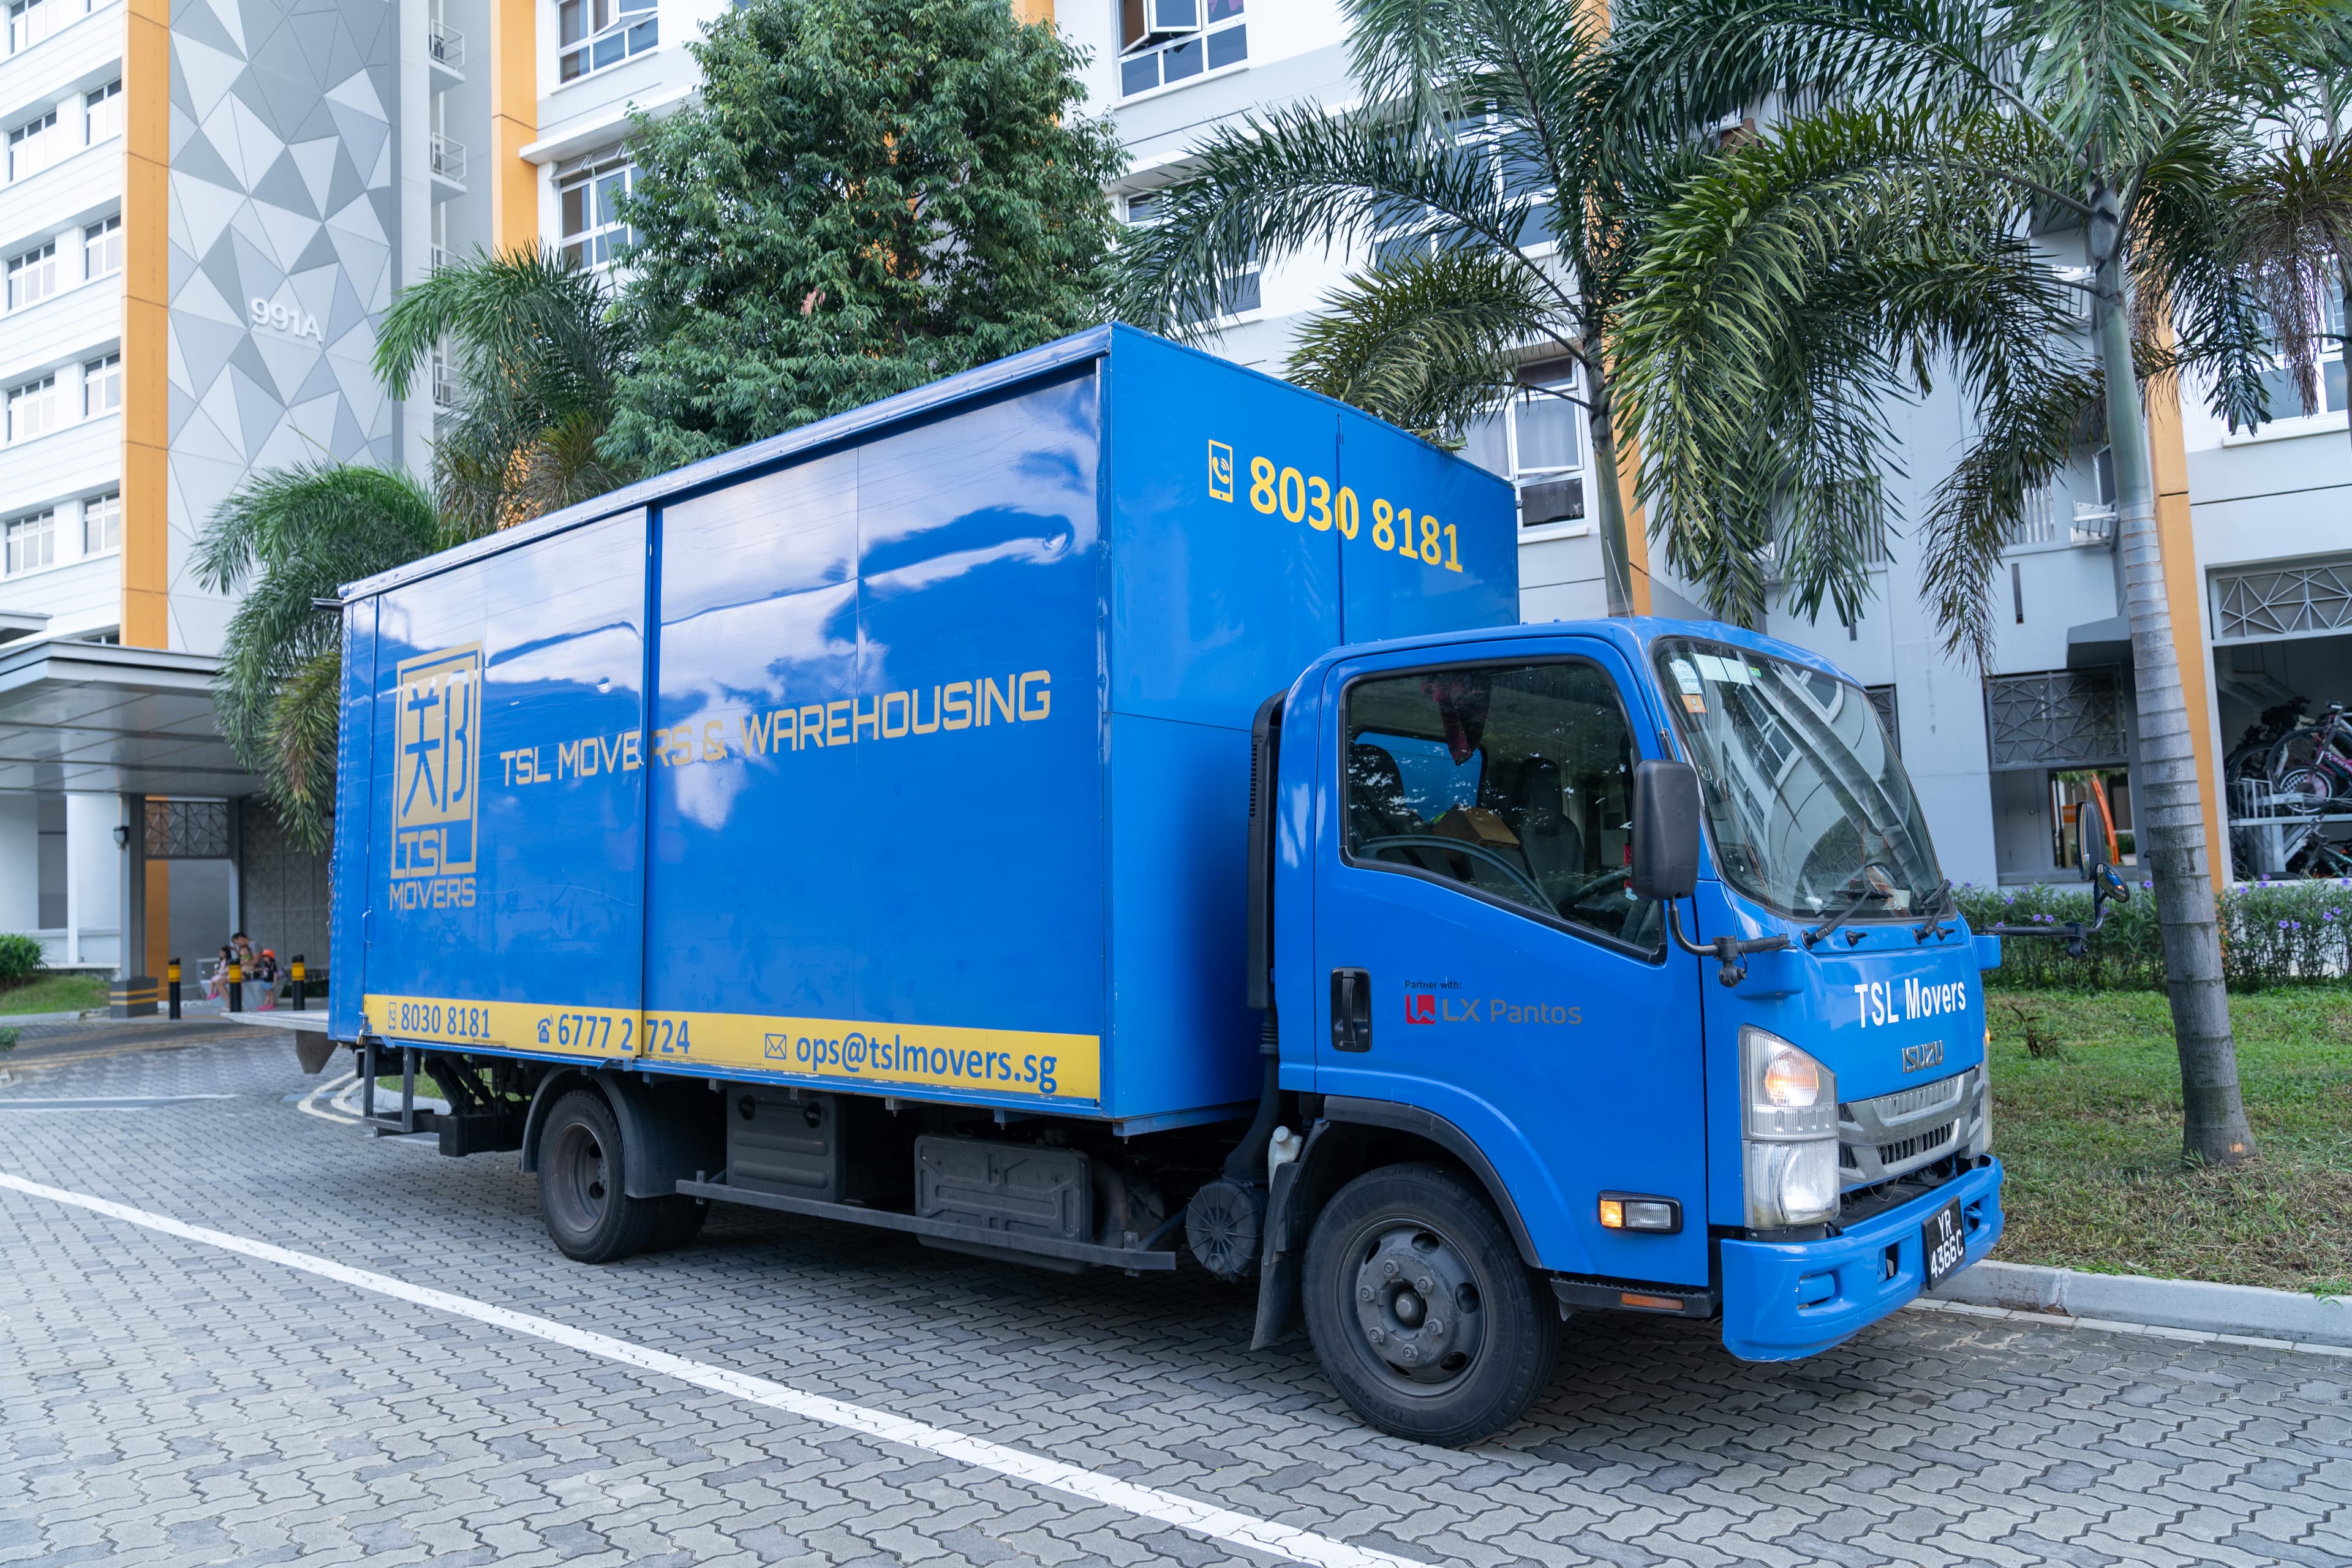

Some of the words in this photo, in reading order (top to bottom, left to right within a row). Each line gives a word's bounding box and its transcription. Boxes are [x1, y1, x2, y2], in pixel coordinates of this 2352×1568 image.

[251, 298, 323, 344] 991A
[1250, 456, 1359, 540] 8030
[1371, 498, 1463, 573] 8181
[500, 747, 551, 787] TSL
[558, 725, 692, 780] MOVERS
[703, 720, 728, 762] &
[739, 669, 1051, 756] WAREHOUSING
[398, 827, 476, 879] TSL
[389, 876, 476, 911] MOVERS
[1404, 980, 1438, 990] Partner
[1440, 980, 1463, 990] with:
[1854, 981, 1899, 1028] TSL
[1904, 977, 1966, 1020] Movers
[401, 1003, 442, 1034] 8030
[447, 1006, 491, 1039] 8181
[558, 1013, 612, 1049] 6777
[1442, 998, 1481, 1022] LX
[1490, 998, 1583, 1025] Pantos
[796, 1032, 1058, 1094] ops@tslmovers.sg
[1901, 1039, 1945, 1074] ISUZU
[1937, 1208, 1953, 1242] YR
[1931, 1229, 1964, 1278] 4366C
